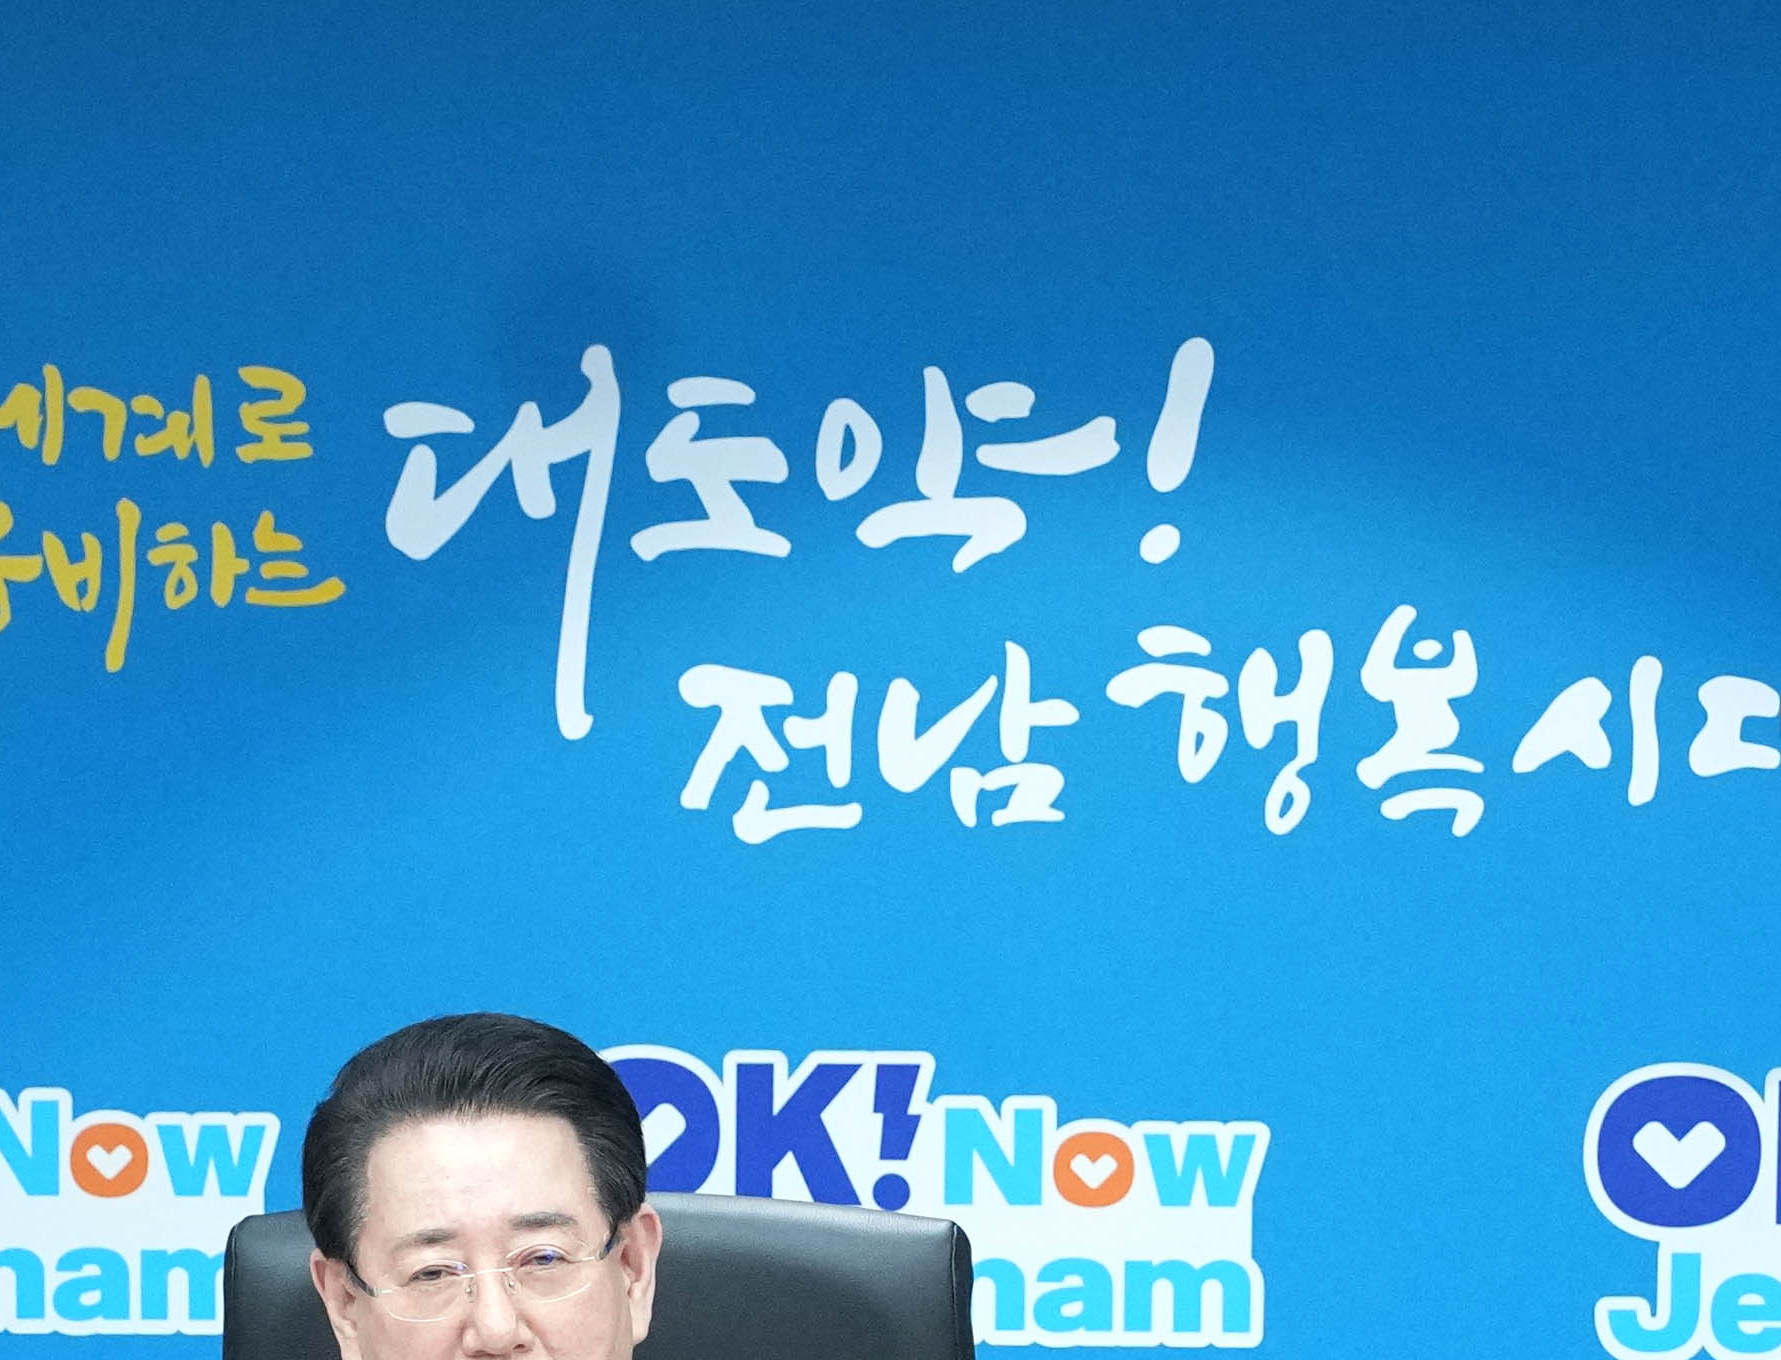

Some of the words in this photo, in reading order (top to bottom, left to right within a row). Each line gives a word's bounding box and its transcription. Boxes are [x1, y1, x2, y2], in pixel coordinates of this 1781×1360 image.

[383, 336, 1216, 740] 대도약!
[677, 640, 1081, 846] 전남
[943, 1108, 1259, 1208] Now
